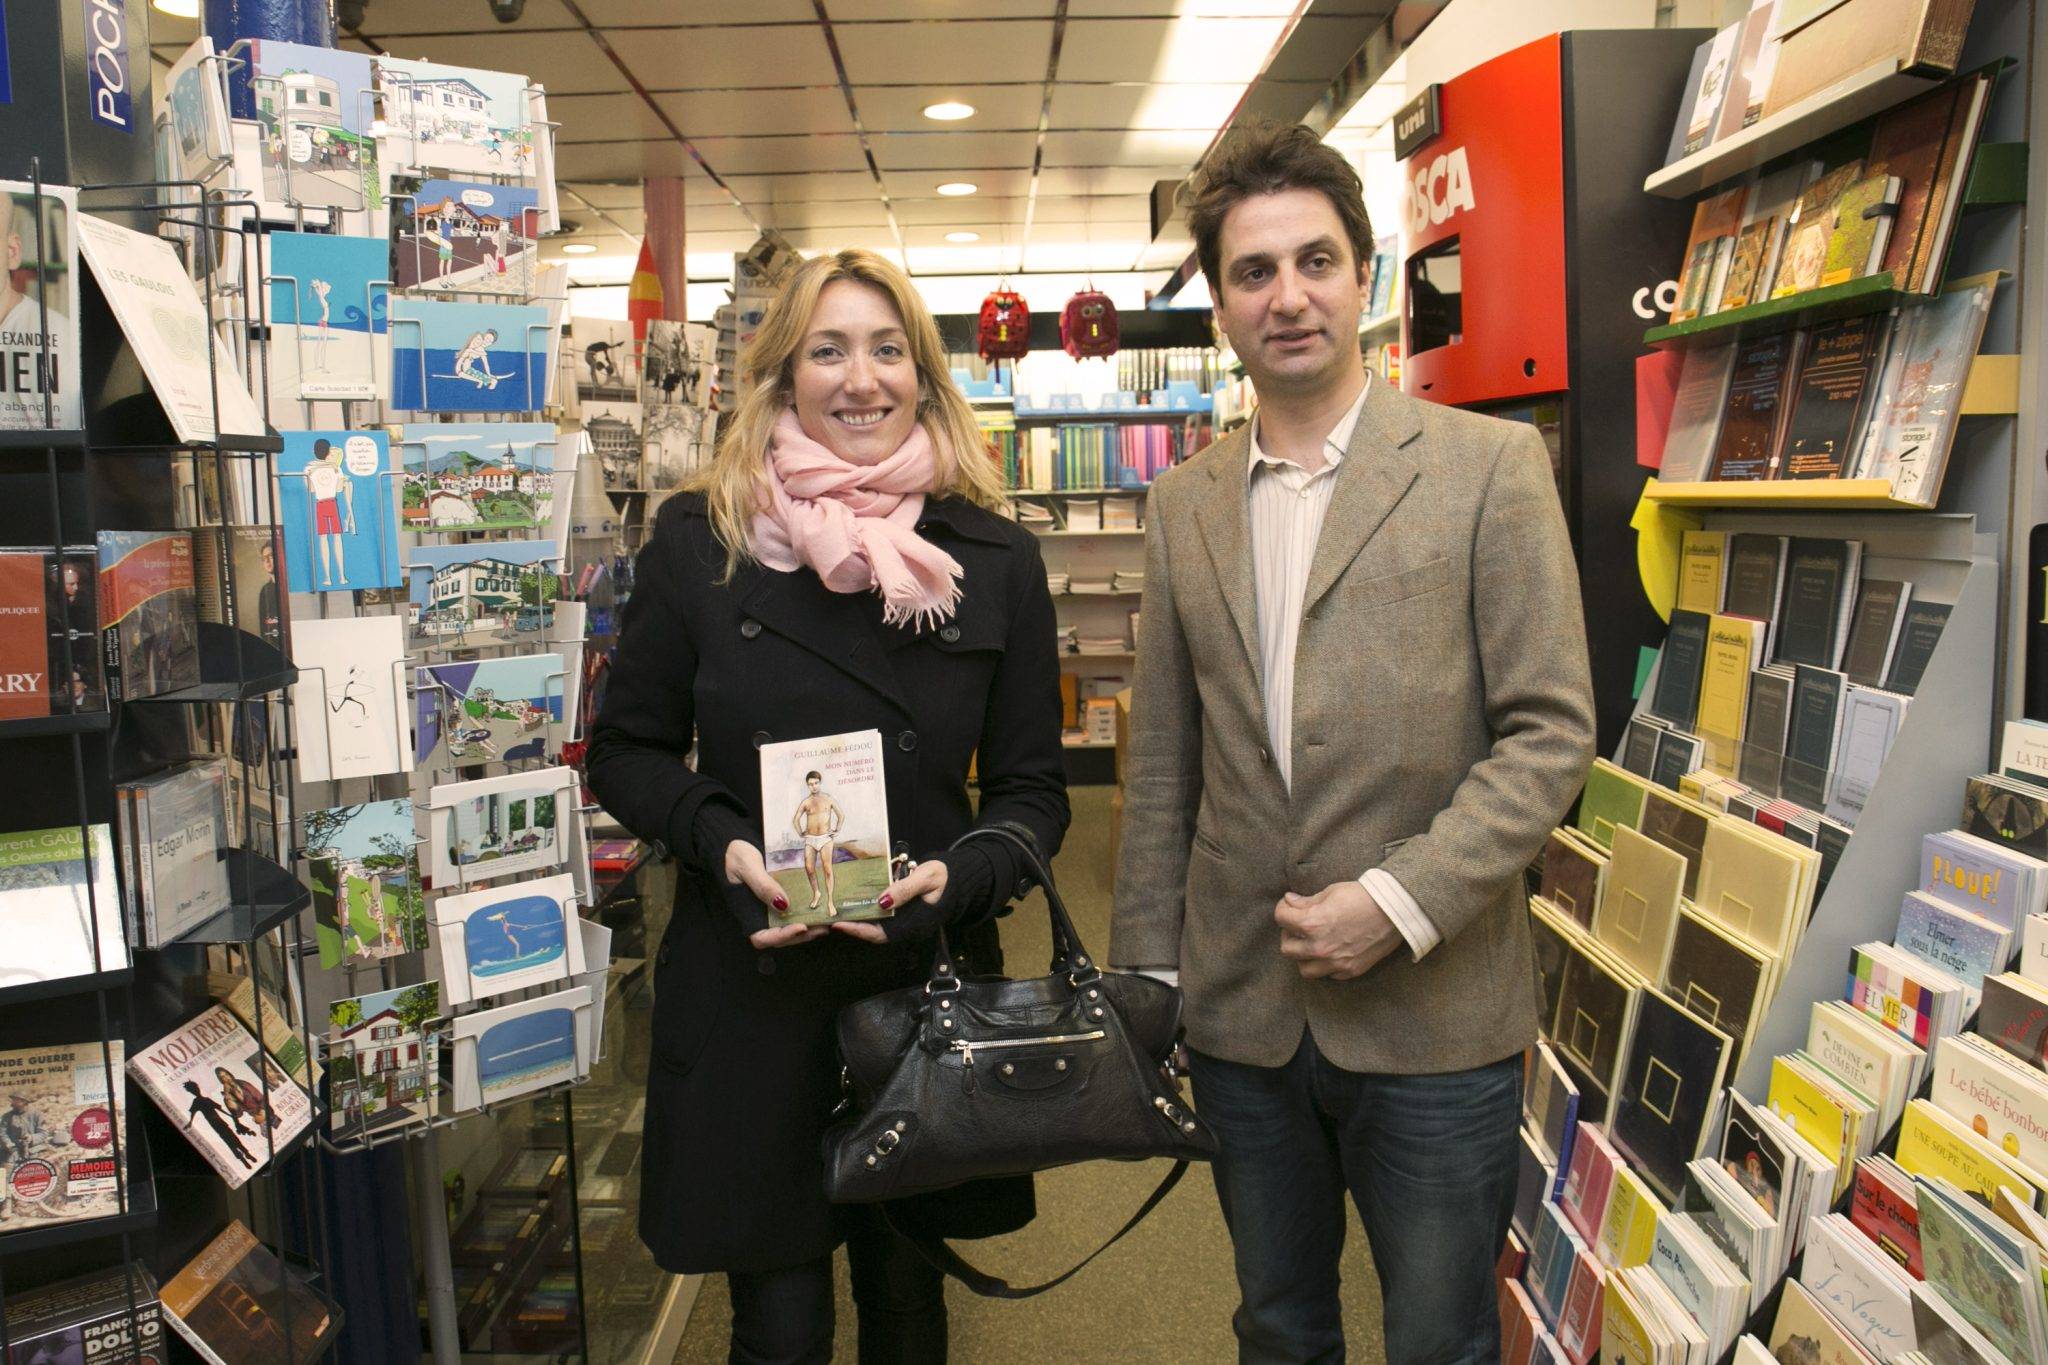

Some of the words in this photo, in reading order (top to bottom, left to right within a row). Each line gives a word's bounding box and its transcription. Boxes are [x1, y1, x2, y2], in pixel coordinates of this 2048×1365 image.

[1399, 98, 1425, 140] uni
[794, 747, 842, 758] GUILLAUME
[157, 835, 184, 857] Edgar
[185, 823, 211, 844] Morin
[1932, 855, 2000, 905] PLOUF!
[1927, 922, 1956, 947] Elmer
[1911, 937, 1928, 954] sous
[1931, 941, 1939, 959] la
[1940, 952, 1968, 973] neige
[1864, 986, 1908, 1028] ELMER
[29, 1053, 75, 1065] GUERRE
[1824, 1047, 1866, 1085] COMBIEN
[1833, 1040, 1861, 1068] DEVINE
[9, 1068, 43, 1077] WORLD
[48, 1065, 69, 1073] WAR
[1950, 1068, 1966, 1091] Le
[1970, 1080, 2000, 1112] bébé
[1914, 1127, 1931, 1147] UNE
[1931, 1141, 1960, 1168] SOUPE
[1961, 1162, 1974, 1177] AU
[70, 1170, 115, 1179] COLLECTIVE
[1857, 1178, 1874, 1200] Sur
[1876, 1191, 1885, 1211] le
[1657, 1239, 1673, 1261] Coco
[84, 1309, 159, 1339] FRANÇISE
